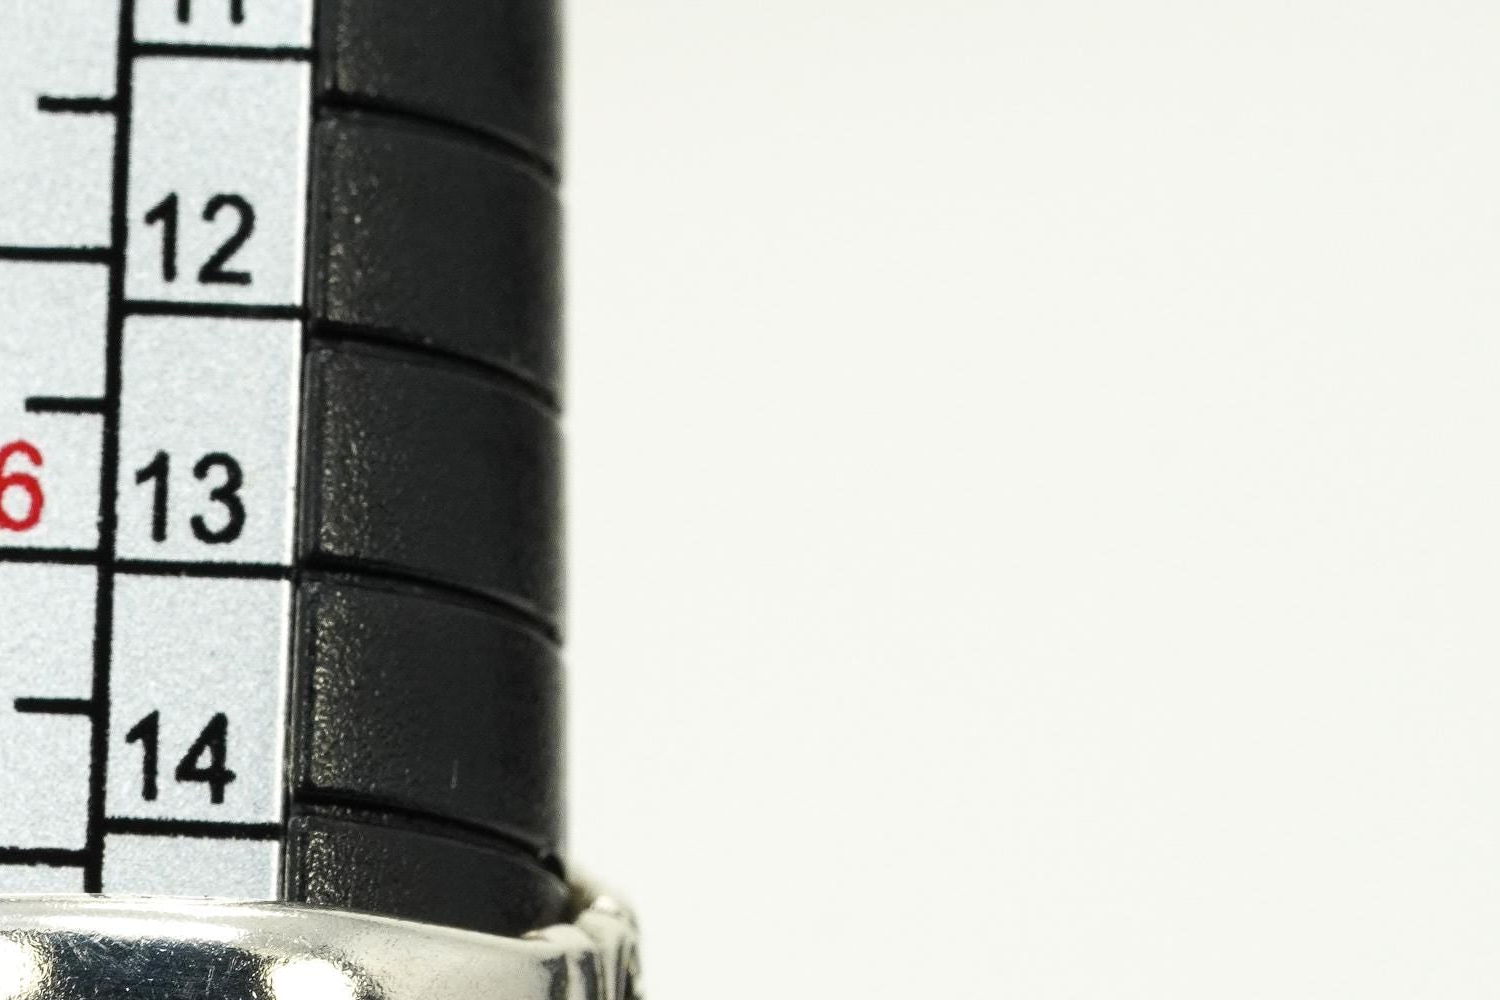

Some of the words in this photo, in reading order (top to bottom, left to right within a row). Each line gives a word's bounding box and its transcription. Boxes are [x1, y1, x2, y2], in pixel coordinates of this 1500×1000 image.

[144, 192, 257, 287] 12
[134, 450, 248, 546] 13
[125, 710, 239, 806] 14
